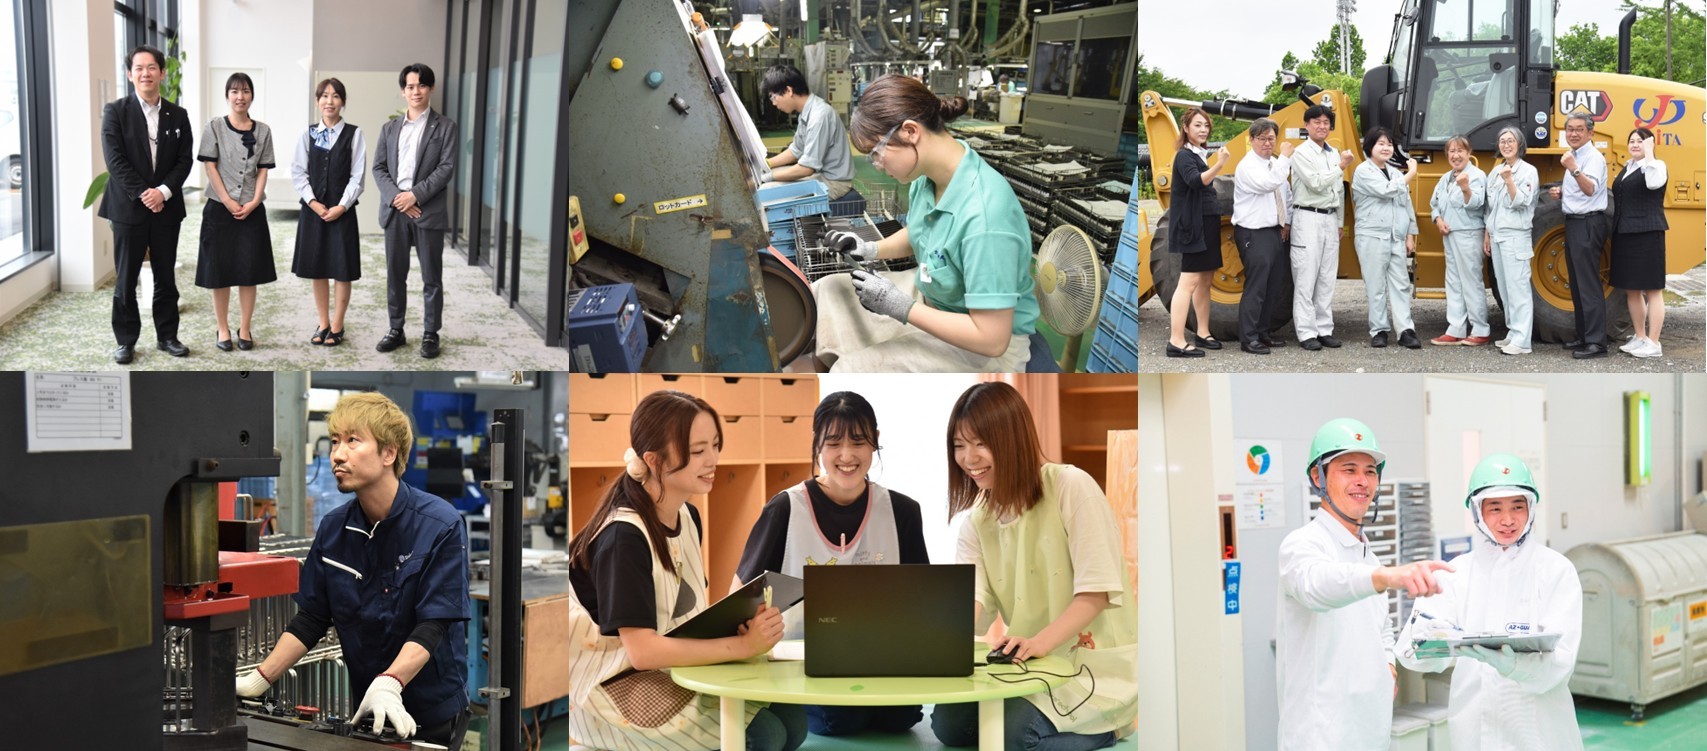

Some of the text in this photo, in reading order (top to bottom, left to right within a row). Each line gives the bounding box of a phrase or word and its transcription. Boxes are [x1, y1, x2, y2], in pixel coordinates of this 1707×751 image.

[1560, 90, 1601, 115] CAT
[658, 199, 692, 210] ロットカード
[1223, 545, 1235, 560] 2
[1227, 565, 1239, 612] 点検中
[818, 616, 838, 624] NEC
